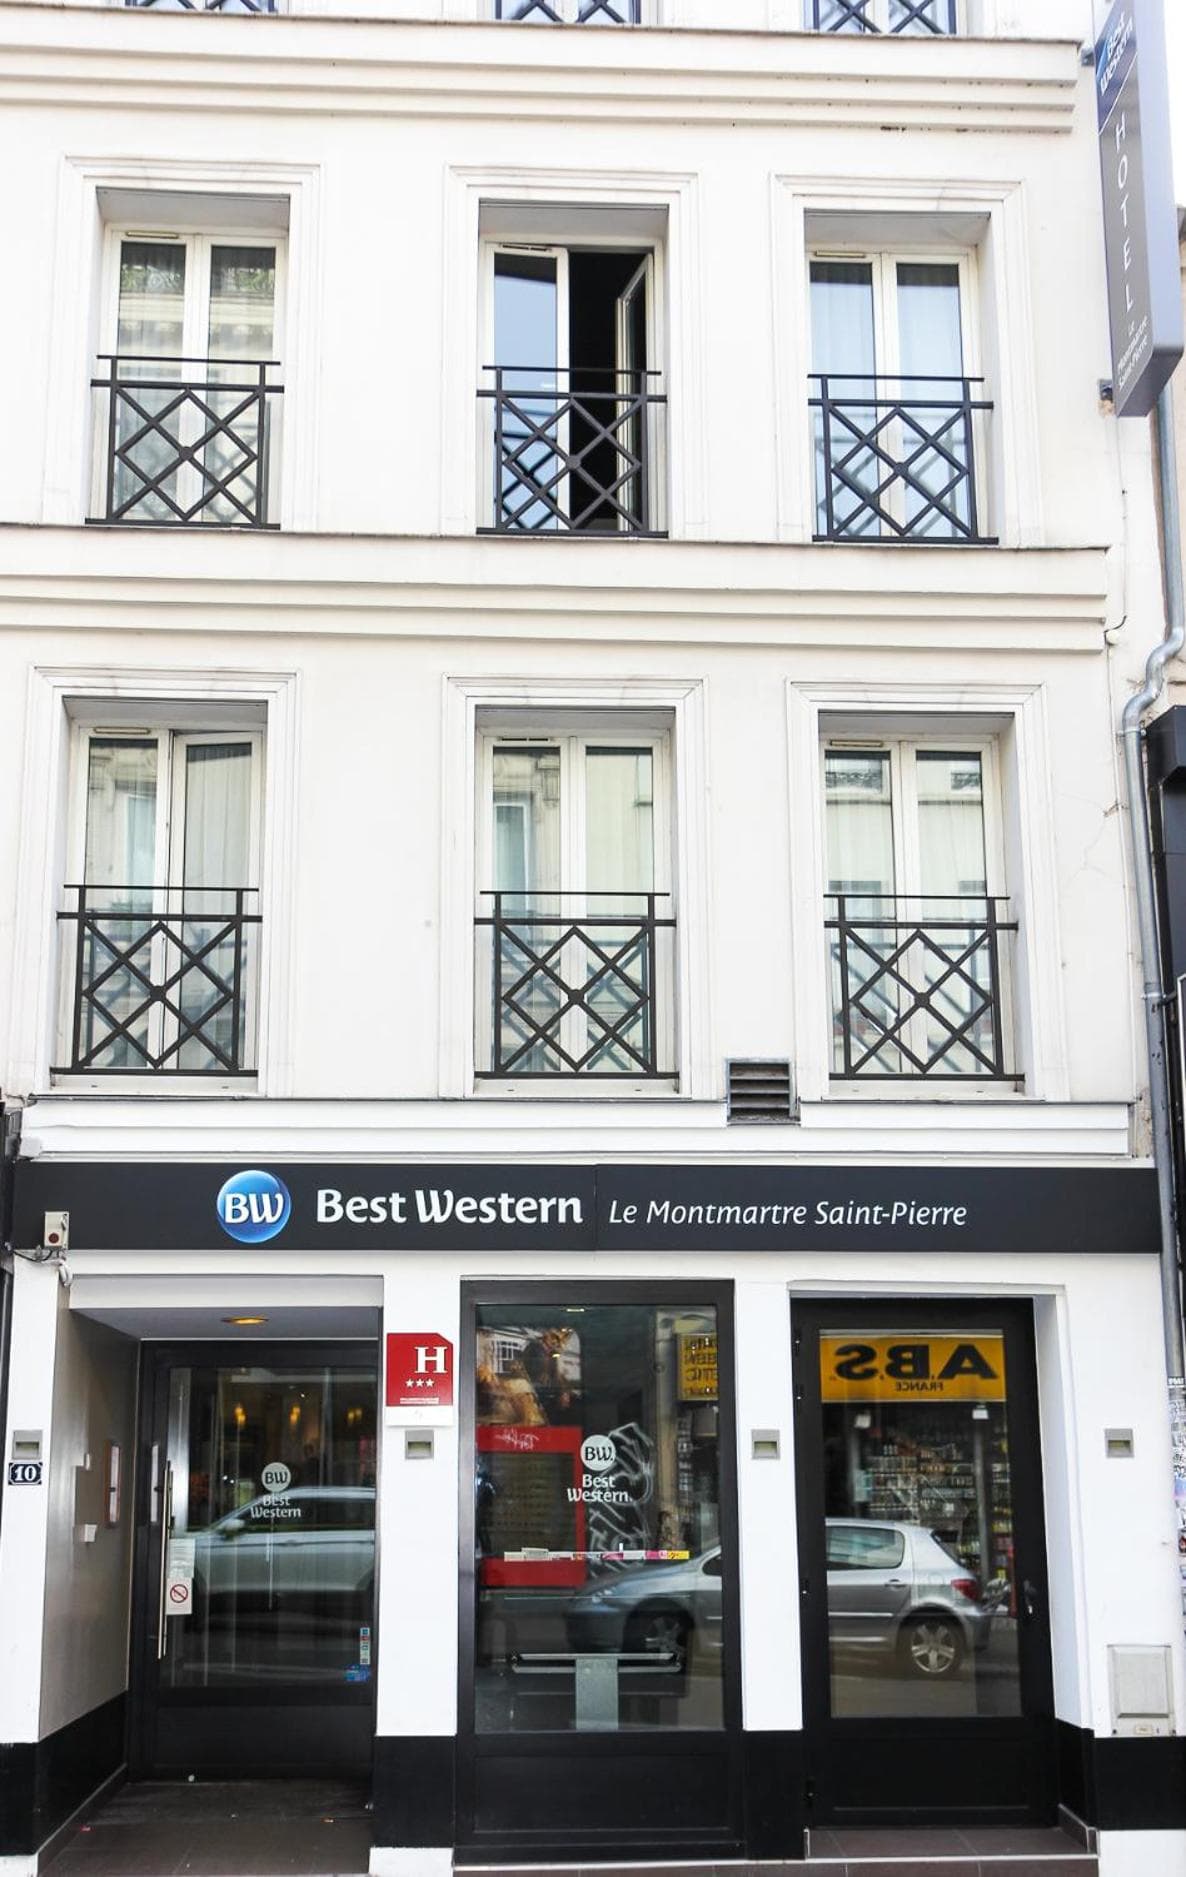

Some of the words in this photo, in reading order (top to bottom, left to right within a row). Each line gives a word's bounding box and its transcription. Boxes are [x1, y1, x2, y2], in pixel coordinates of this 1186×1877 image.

[1115, 113, 1134, 313] HOTEL
[224, 1193, 284, 1224] BW
[316, 1189, 407, 1224] Best
[415, 1189, 583, 1224] Western
[609, 1200, 637, 1224] Le
[646, 1200, 807, 1225] Montmartre
[815, 1200, 967, 1226] Saint-Pierre
[414, 1346, 448, 1374] H
[584, 1446, 613, 1461] BW
[14, 1465, 37, 1482] 10
[264, 1471, 289, 1485] BW
[582, 1474, 616, 1488] Best
[262, 1494, 291, 1507] Best
[566, 1488, 629, 1503] Western
[250, 1506, 302, 1519] Western
